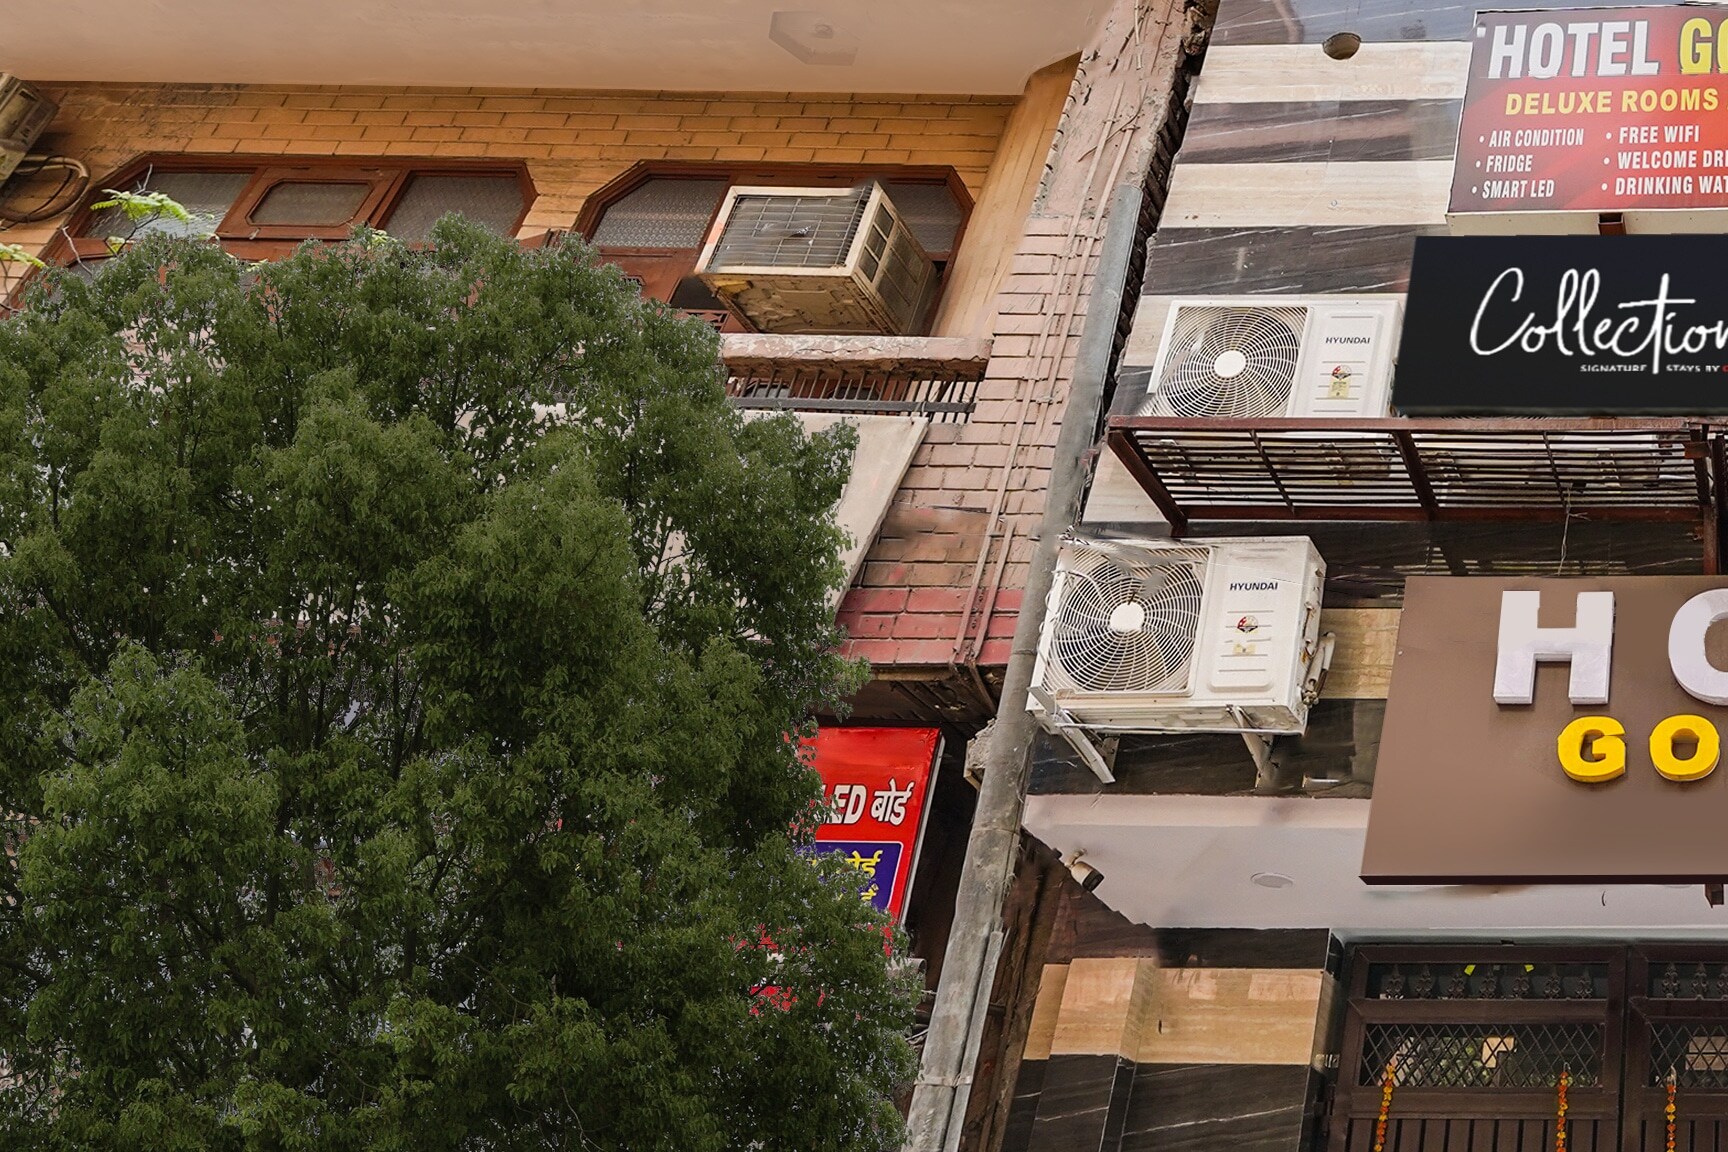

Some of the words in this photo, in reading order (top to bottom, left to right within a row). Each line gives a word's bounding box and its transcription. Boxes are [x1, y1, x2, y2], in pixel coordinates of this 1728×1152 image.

[1487, 18, 1660, 79] HOTEL
[1505, 91, 1612, 116] DELUXE
[1621, 87, 1719, 113] ROOMS
[1488, 130, 1511, 148] AIR
[1515, 128, 1584, 147] CONDITION
[1618, 126, 1659, 144] FREE
[1664, 125, 1700, 143] WIFI
[1485, 154, 1534, 173] FRIDGE
[1617, 150, 1698, 170] WELCOME
[1482, 180, 1528, 199] SMART
[1530, 179, 1555, 198] LED
[1615, 176, 1693, 196] DRINKING
[1325, 336, 1371, 345] HYUNDAI
[1580, 364, 1648, 372] SIGNATURE
[1666, 364, 1701, 372] STAYS
[1229, 581, 1278, 591] HYUNDAI
[870, 778, 915, 826] बोर्ड
